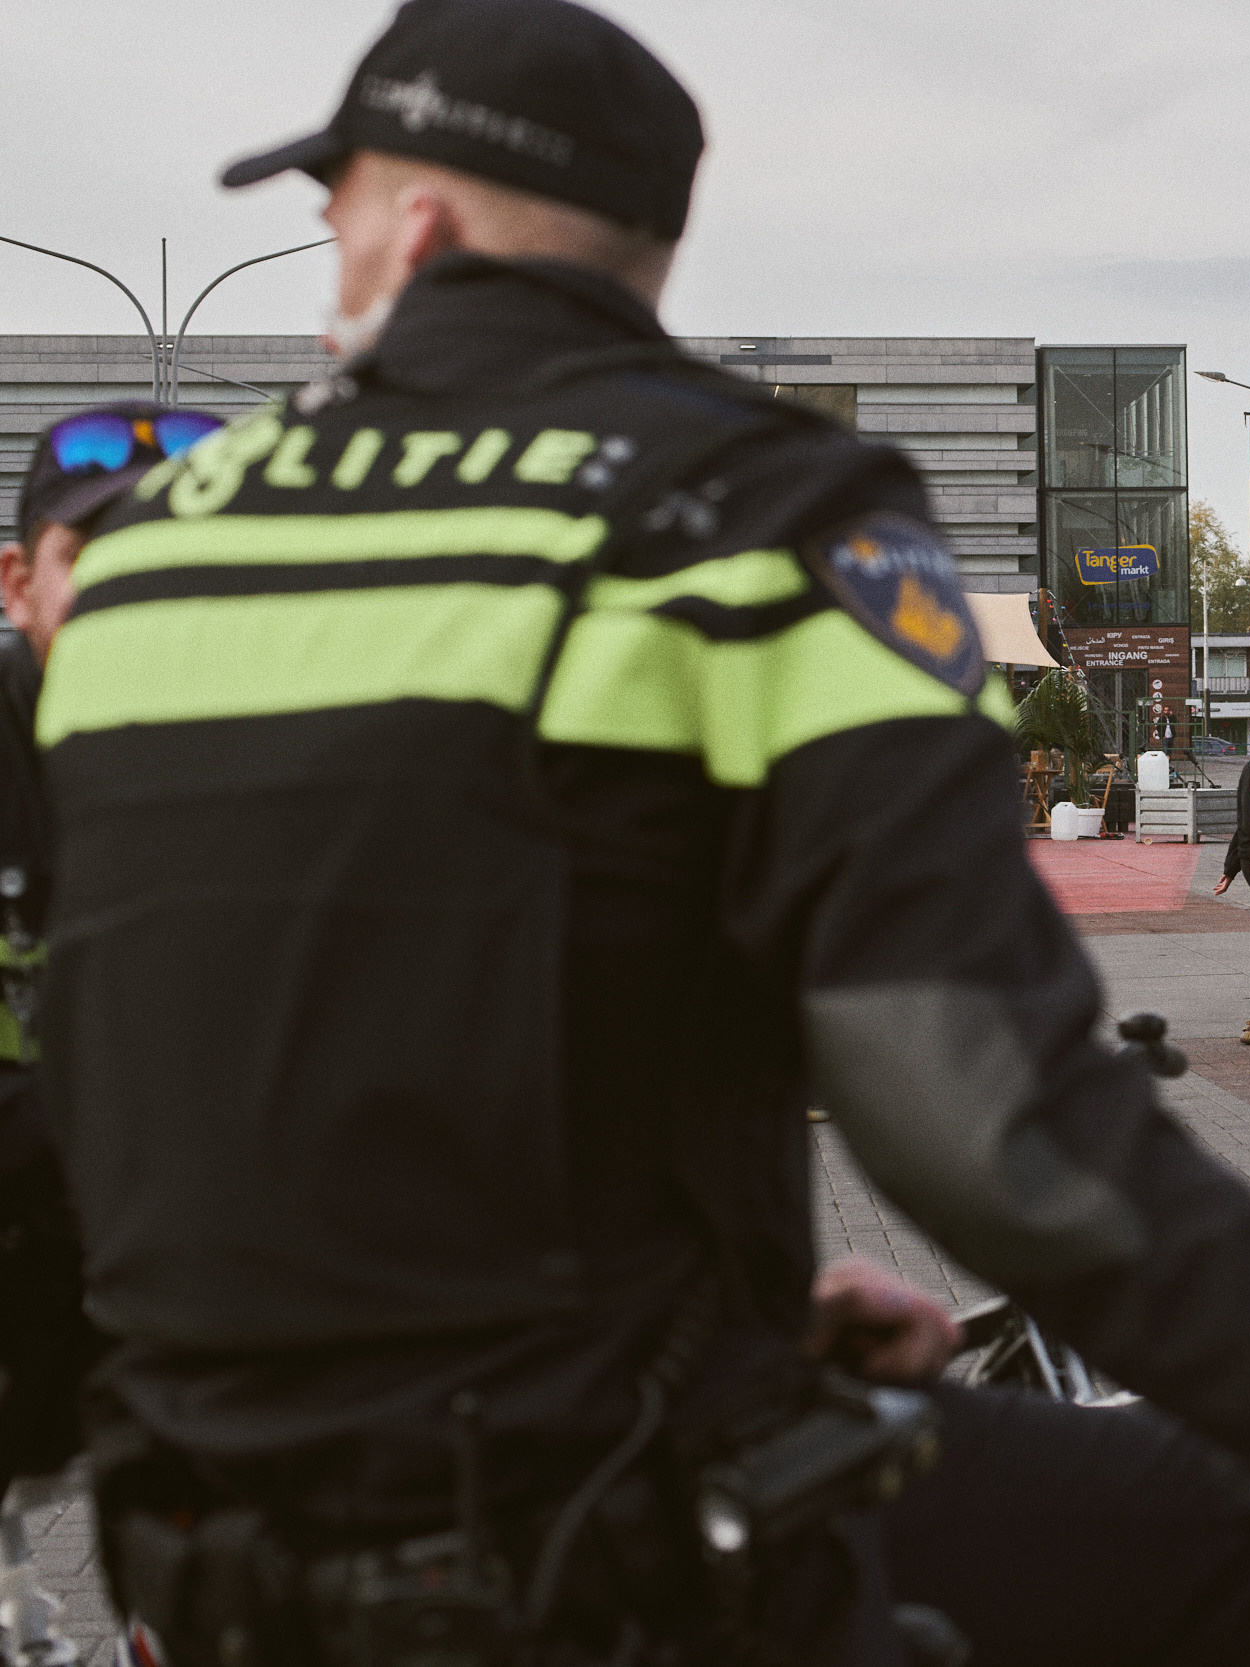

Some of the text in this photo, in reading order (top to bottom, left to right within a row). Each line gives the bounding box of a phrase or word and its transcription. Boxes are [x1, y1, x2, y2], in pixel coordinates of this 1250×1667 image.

[1082, 550, 1137, 573] Tanger
[1121, 565, 1149, 575] markt
[1108, 651, 1148, 660] INGANG
